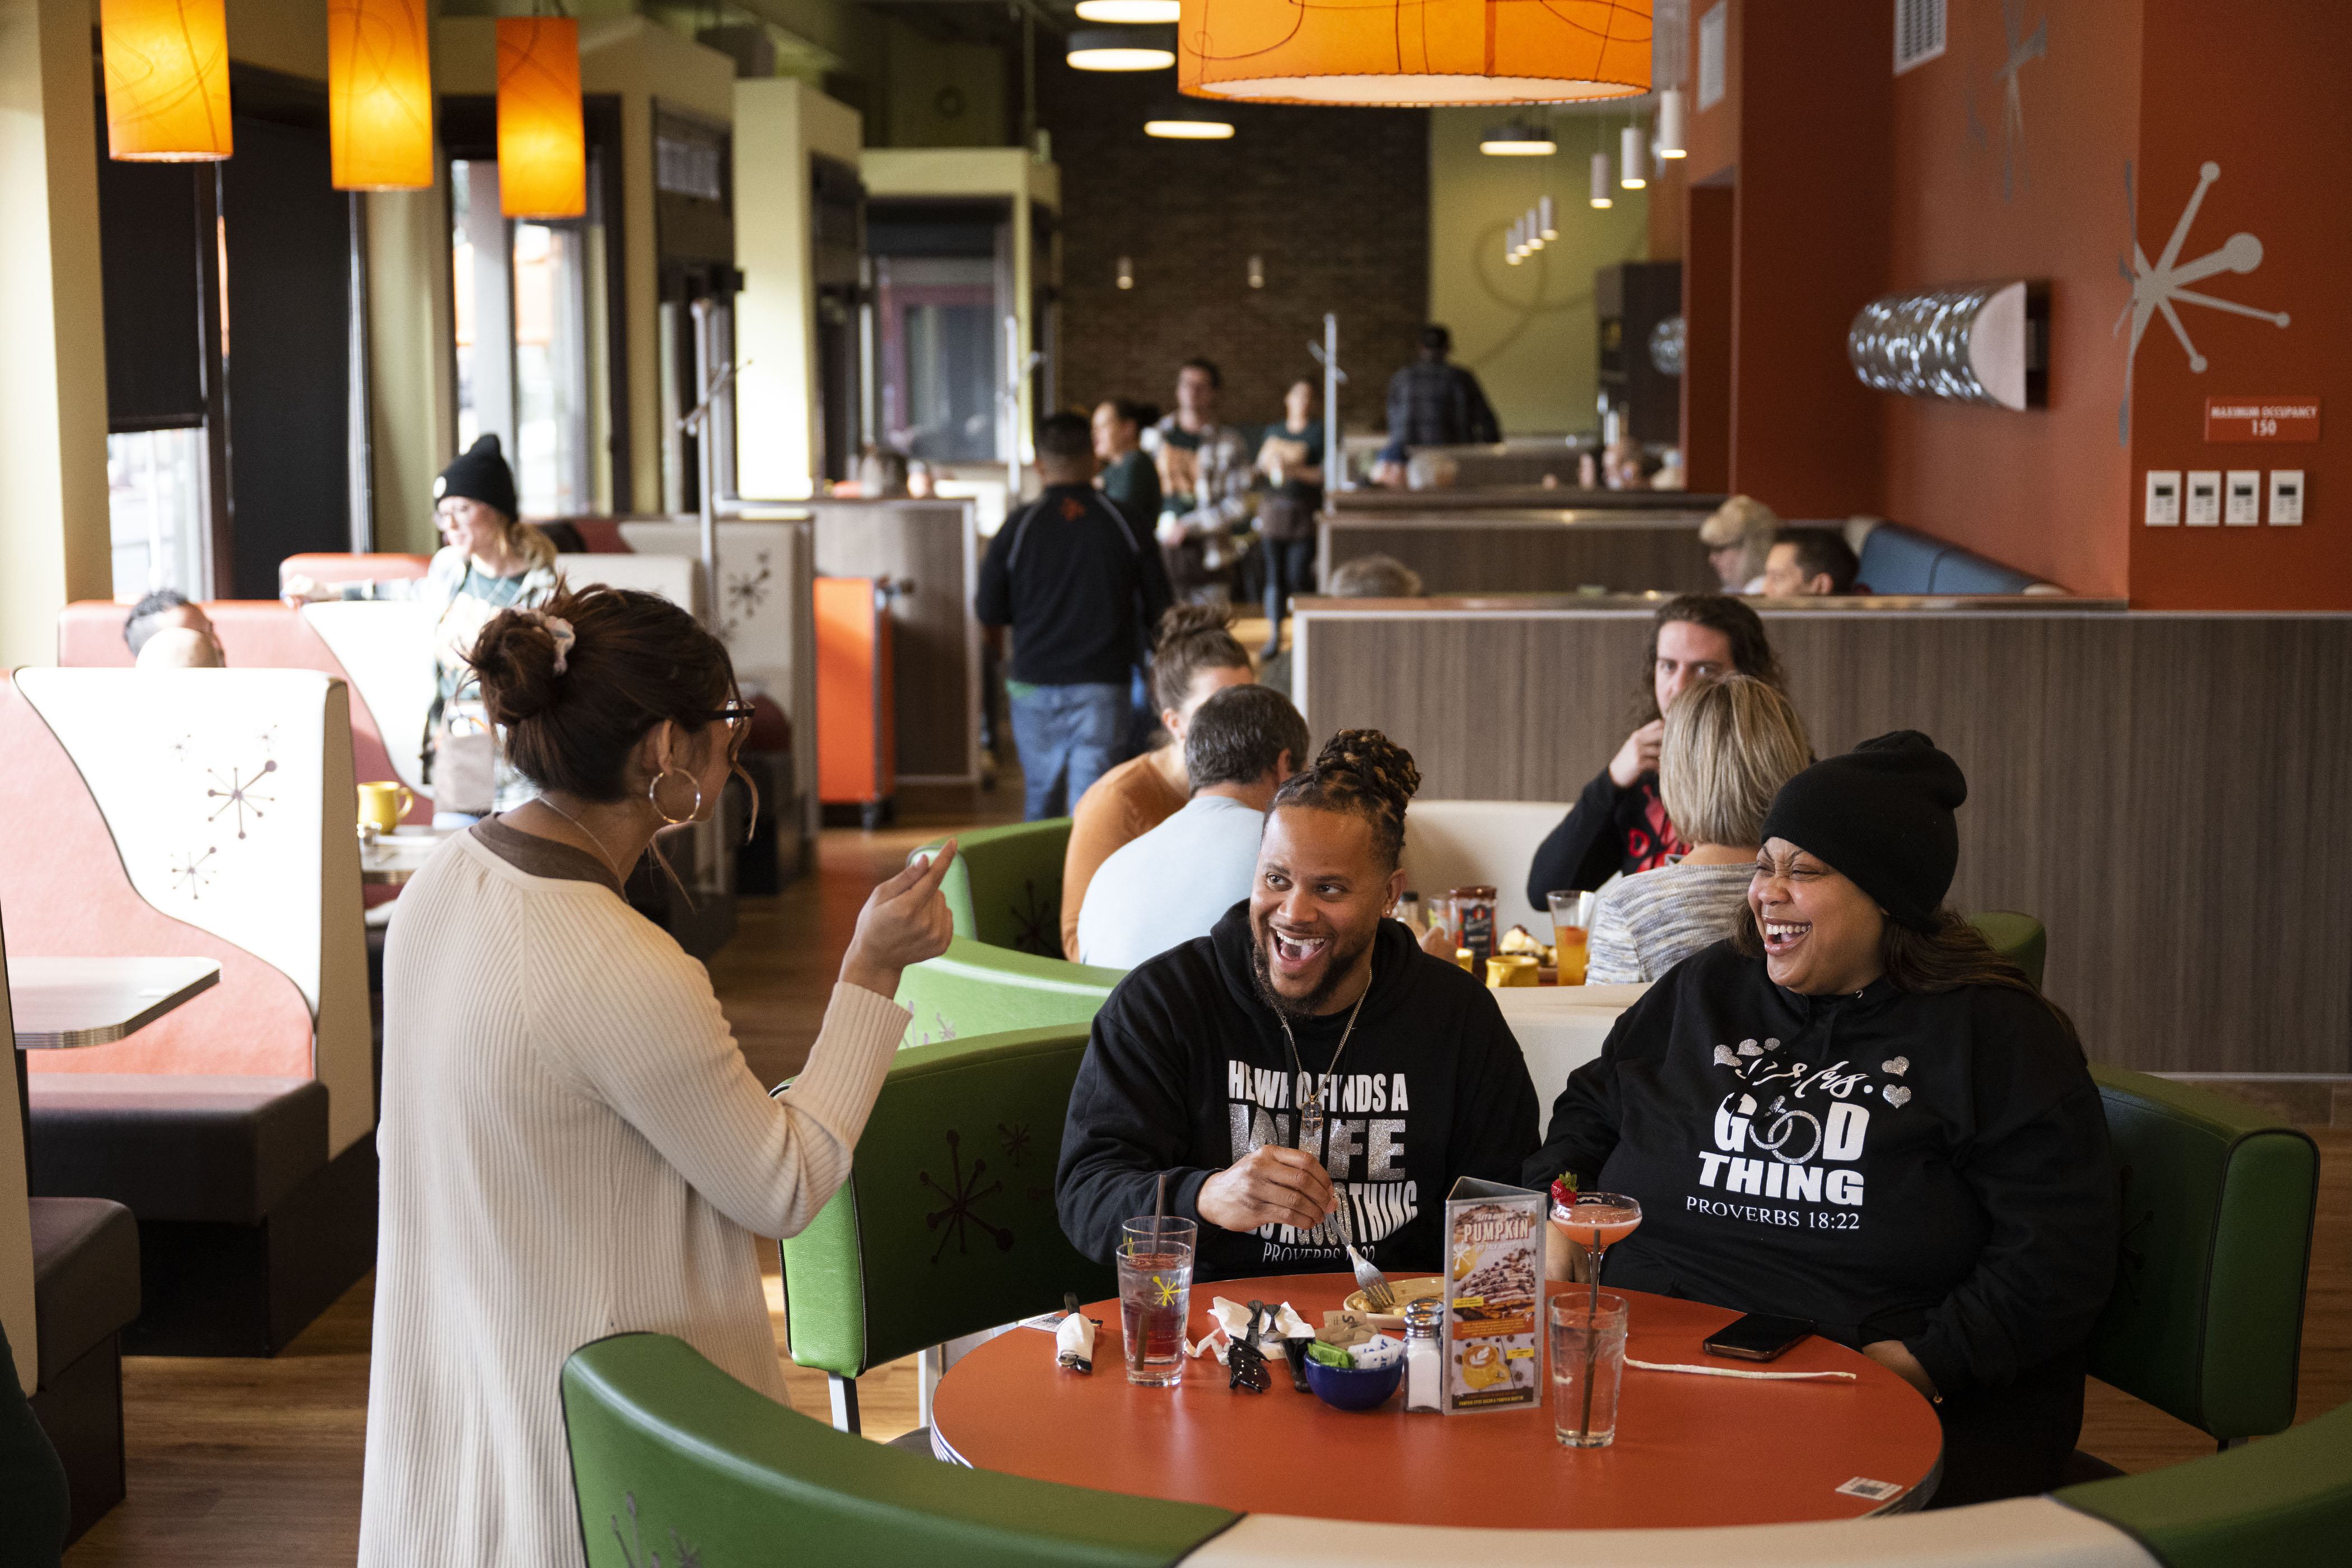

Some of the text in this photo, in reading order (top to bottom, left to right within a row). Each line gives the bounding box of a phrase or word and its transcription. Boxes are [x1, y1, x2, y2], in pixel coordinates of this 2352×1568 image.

[2211, 405, 2317, 419] MAXIMUM OCCUPANCY
[2252, 419, 2277, 436] 150
[1229, 1060, 1256, 1101] HE
[1318, 1073, 1386, 1112] FINDS
[1391, 1073, 1408, 1111] A
[1698, 1151, 1864, 1206] THING
[1349, 1180, 1418, 1243] THING
[1686, 1196, 1860, 1229] PROVERBS 18:22
[1464, 1218, 1530, 1243] PUMPKIN
